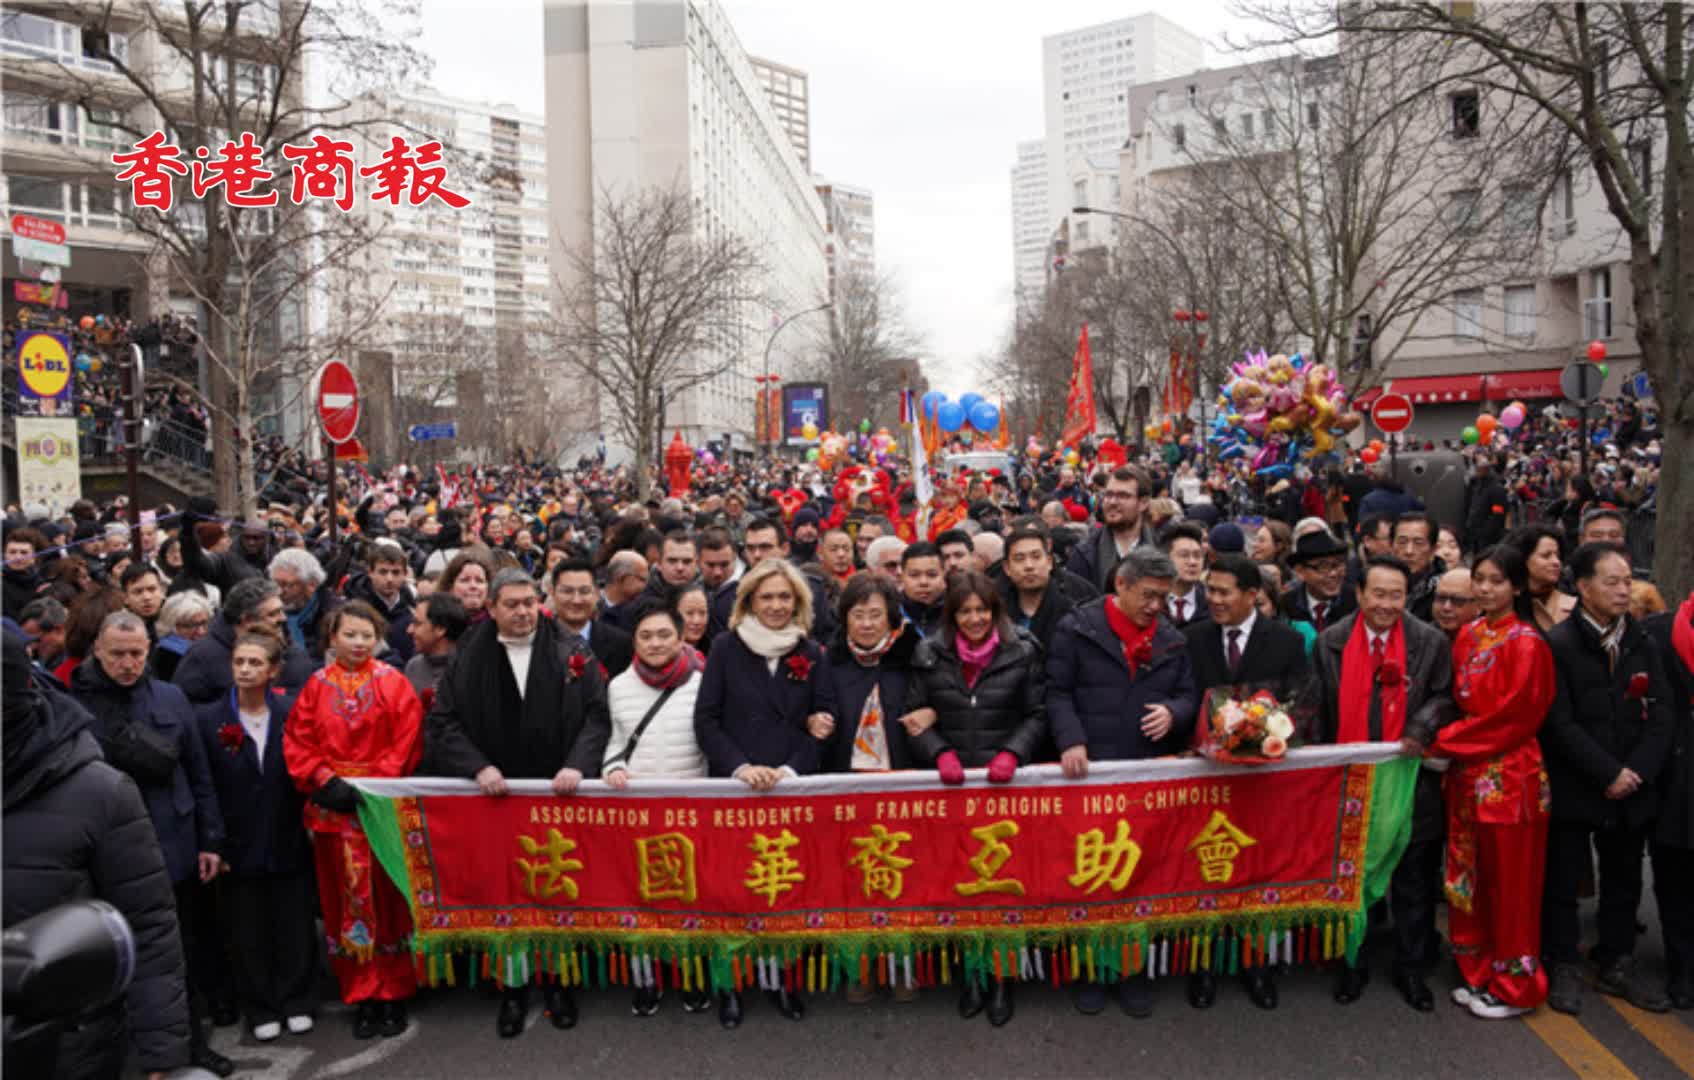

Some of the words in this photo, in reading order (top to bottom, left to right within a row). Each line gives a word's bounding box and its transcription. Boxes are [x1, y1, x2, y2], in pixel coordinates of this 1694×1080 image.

[530, 805, 649, 826] ASSOCIATION
[664, 808, 698, 828] DES
[713, 805, 814, 828] RESIDENTS
[834, 804, 856, 822] EN
[876, 799, 948, 820] FRANCE
[965, 796, 1063, 817] D'ORIGINE
[516, 810, 1257, 906] 法國華裔互助會
